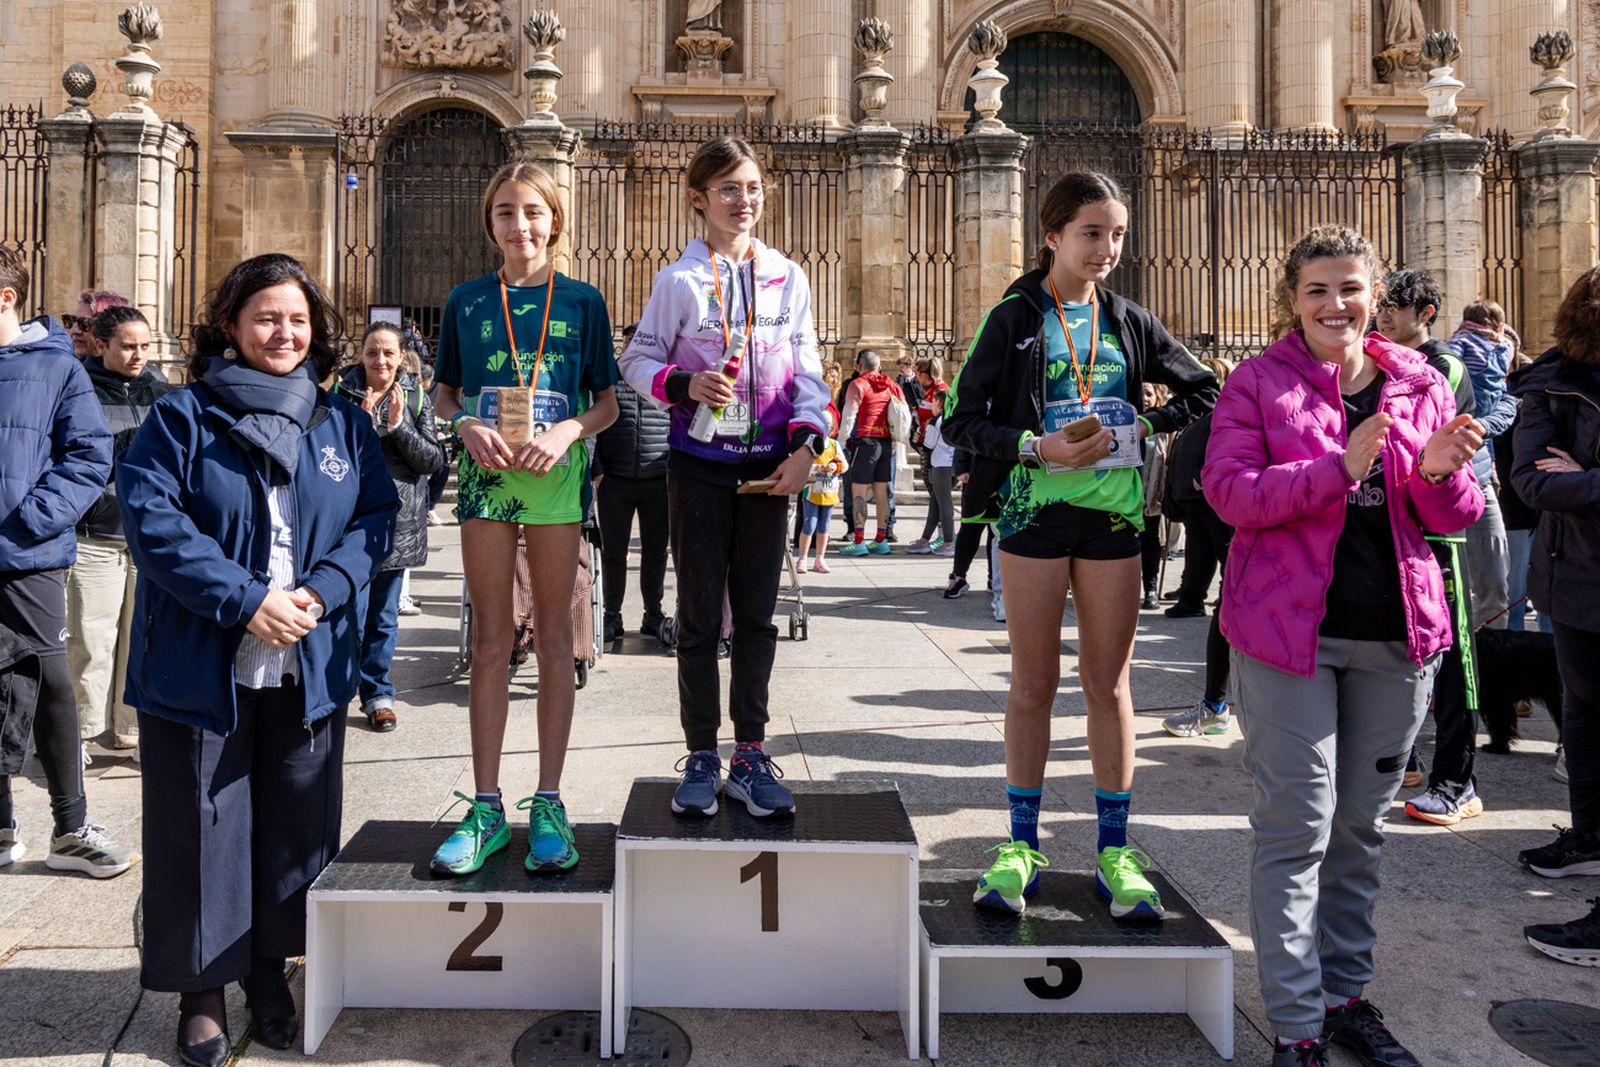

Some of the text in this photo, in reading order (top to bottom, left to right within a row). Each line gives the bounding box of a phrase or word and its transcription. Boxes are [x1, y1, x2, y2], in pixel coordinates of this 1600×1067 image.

[511, 350, 565, 363] Fundción
[511, 360, 552, 373] Unicja
[1069, 362, 1123, 373] Fndación
[532, 398, 560, 407] AMINATA
[740, 851, 779, 932] 1
[445, 901, 504, 972] 2
[1023, 957, 1083, 1000] 3
